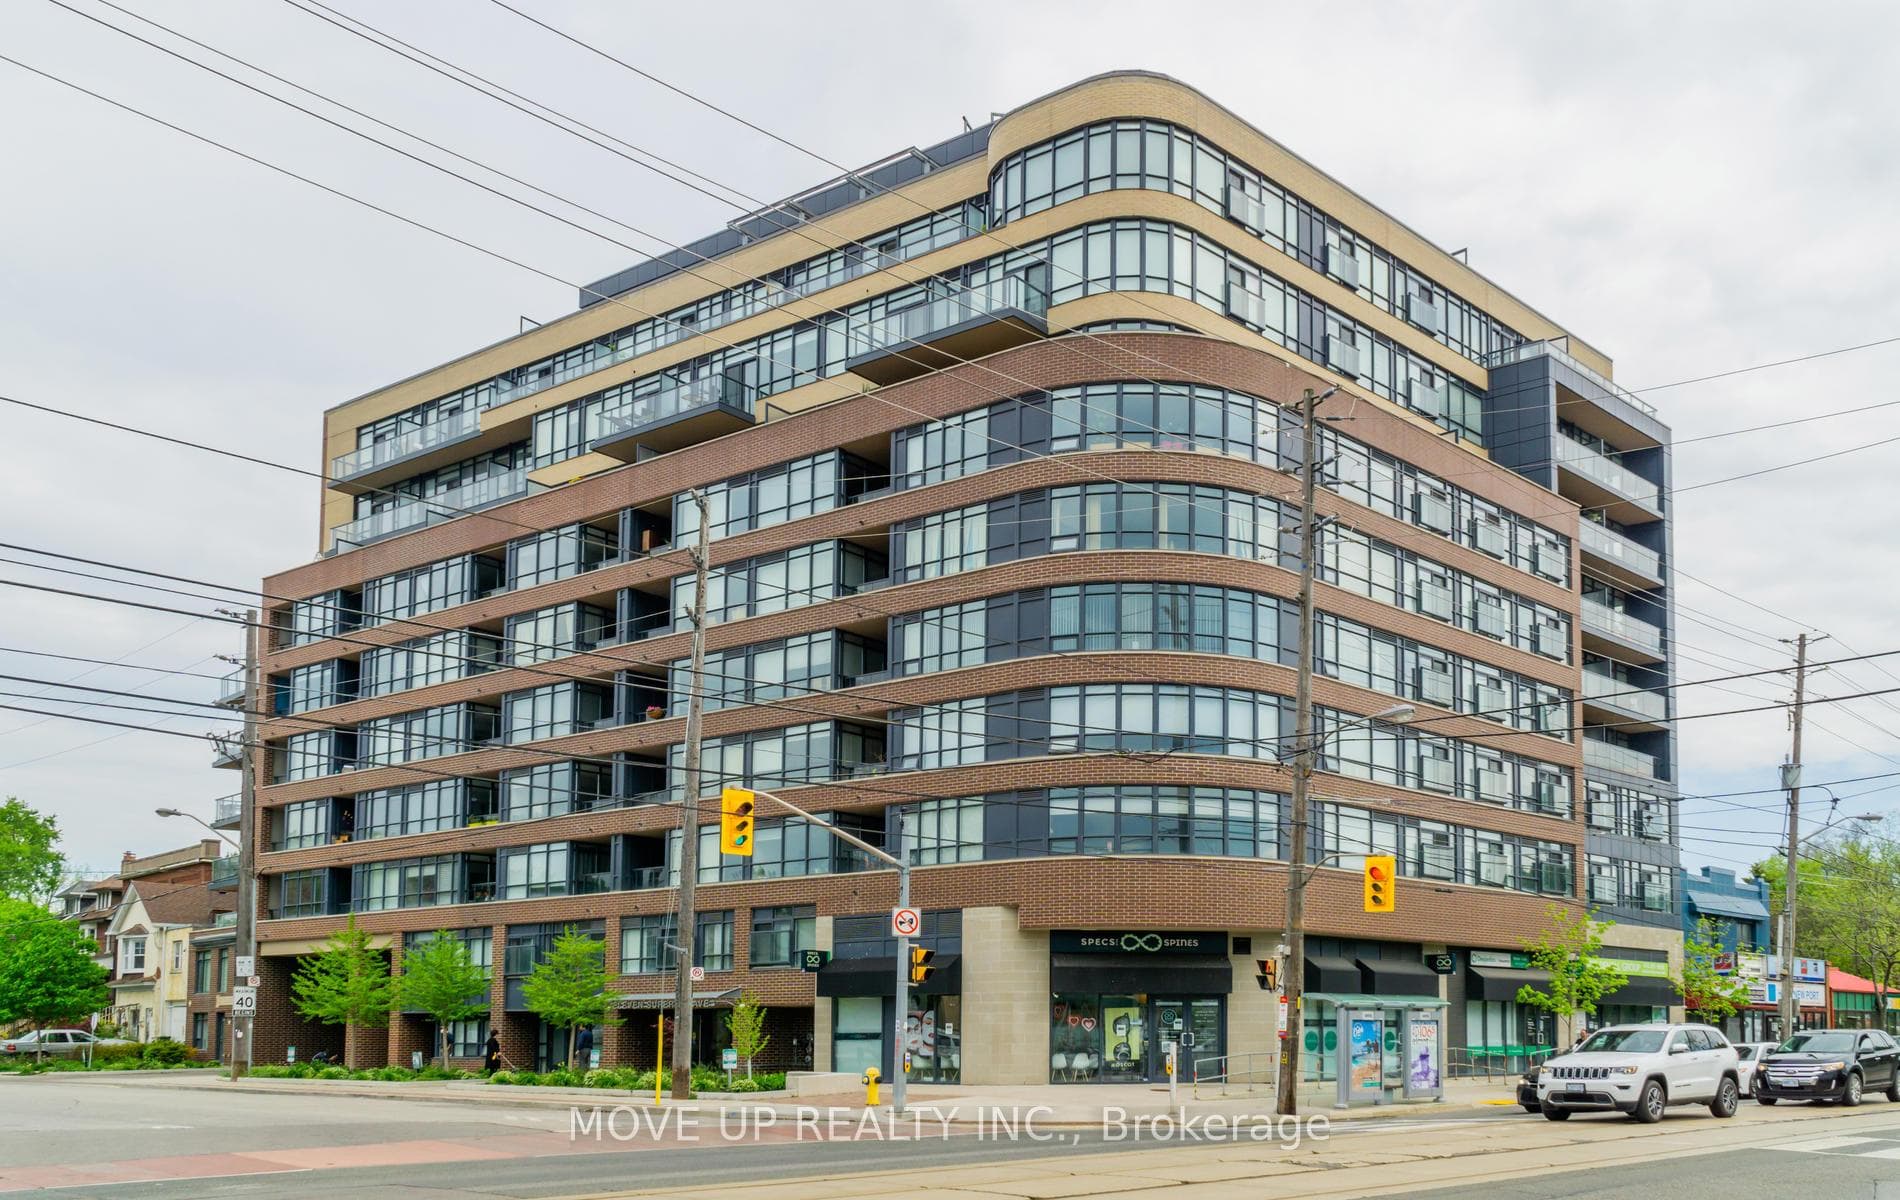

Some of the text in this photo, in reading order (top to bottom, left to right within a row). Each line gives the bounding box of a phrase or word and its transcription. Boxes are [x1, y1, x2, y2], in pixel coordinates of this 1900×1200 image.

[1081, 938, 1115, 946] SPECS
[1164, 939, 1199, 947] SPINES
[235, 996, 253, 1008] 40
